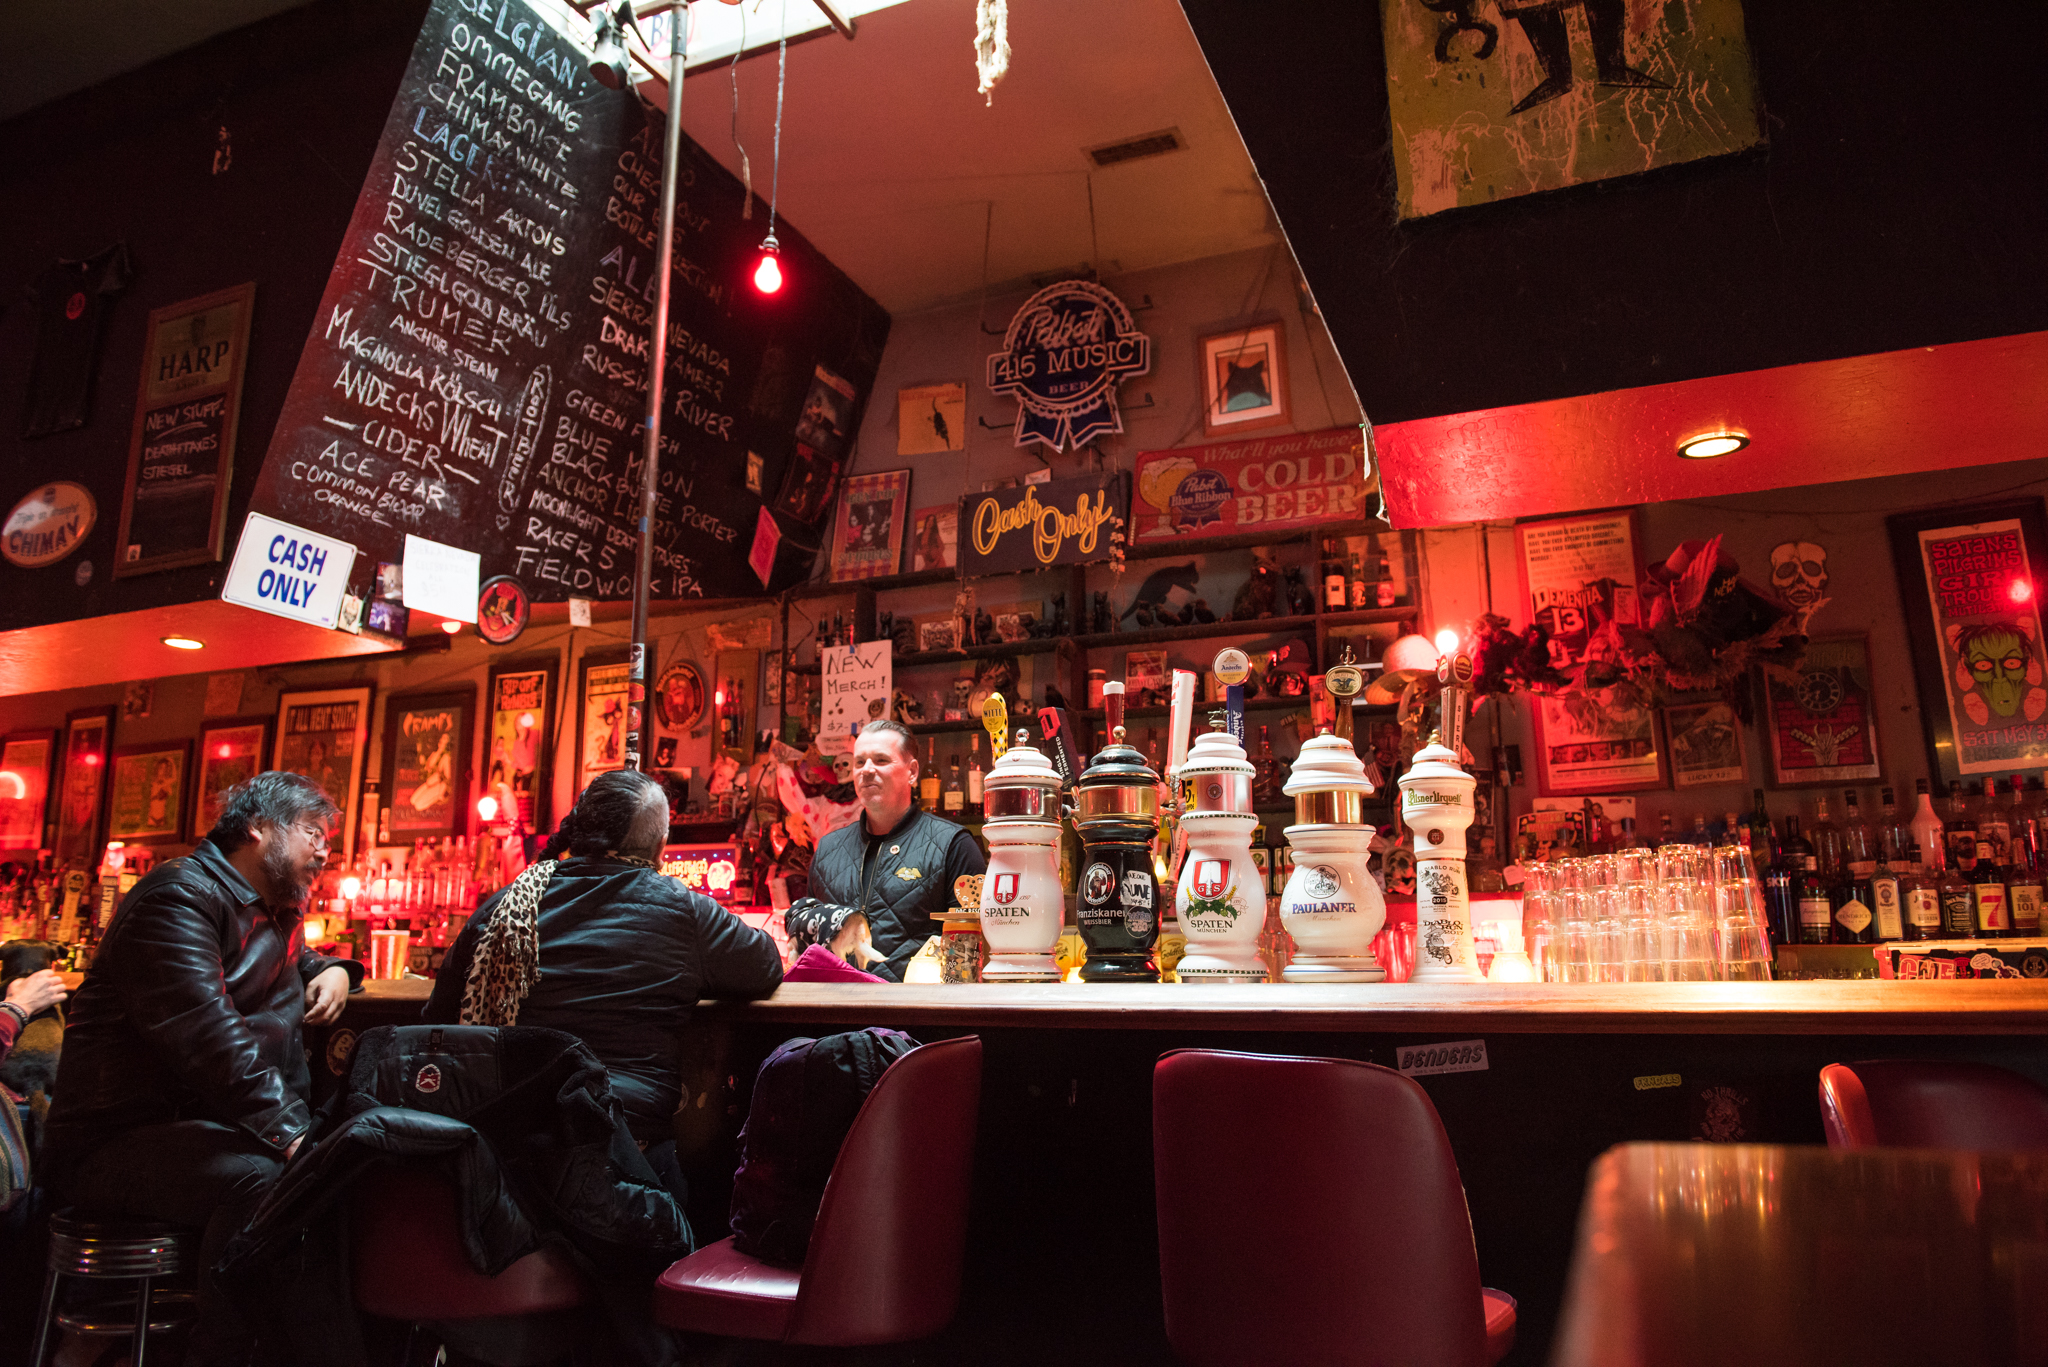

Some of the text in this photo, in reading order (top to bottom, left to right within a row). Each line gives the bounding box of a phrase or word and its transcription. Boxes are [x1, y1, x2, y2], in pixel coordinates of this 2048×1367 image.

[451, 23, 582, 132] OMMEGANG
[428, 82, 579, 199] CHIMAY WHITE
[396, 141, 485, 216] STELLA
[391, 171, 552, 287] DUVEL GOLDEN ALE
[383, 201, 531, 308] RADEBERGER
[357, 257, 512, 355] TRUMER
[1025, 305, 1104, 349] Pabst
[158, 339, 229, 383] HARP
[389, 314, 499, 382] ANCHOR STEAM
[666, 322, 731, 377] NEVADA
[997, 339, 1135, 381] 415 MUSIC
[1049, 381, 1090, 394] BEER
[147, 409, 179, 432] NEW
[565, 389, 628, 431] GREEN
[675, 389, 733, 441] RIVER
[555, 416, 612, 462] BLUE
[1268, 440, 1302, 458] you
[291, 461, 380, 500] COMMON
[319, 440, 446, 511] ACE PEAR
[536, 462, 608, 512] ANCHOR
[551, 442, 613, 488] BLACK
[682, 505, 737, 543] PORTER
[1184, 477, 1218, 492] Pabst
[1237, 452, 1357, 492] COLD
[314, 489, 393, 528] ORANGE
[528, 489, 605, 535] MOONLIGHT
[1195, 490, 1231, 503] Ribbon
[1236, 484, 1358, 525] BEER
[9, 515, 80, 557] CHIMAY
[525, 517, 593, 563] RACER
[972, 485, 1043, 555] Cash
[268, 534, 328, 576] CASH
[1934, 550, 2022, 575] PILGRIMS
[257, 568, 317, 608] ONLY
[672, 569, 703, 597] IPA
[1553, 607, 1584, 634] 13
[826, 649, 882, 675] NEW
[403, 712, 453, 737] CRAMPS
[983, 706, 1003, 718] WITTE
[1408, 788, 1461, 806] Pilsner Urquell
[984, 907, 1030, 918] SPATEN
[1190, 920, 1233, 929] SPATEN
[1292, 902, 1357, 914] PAULANER
[1981, 895, 2002, 927] 7
[2017, 903, 2034, 911] 101
[1402, 1045, 1483, 1069] BENDERS
